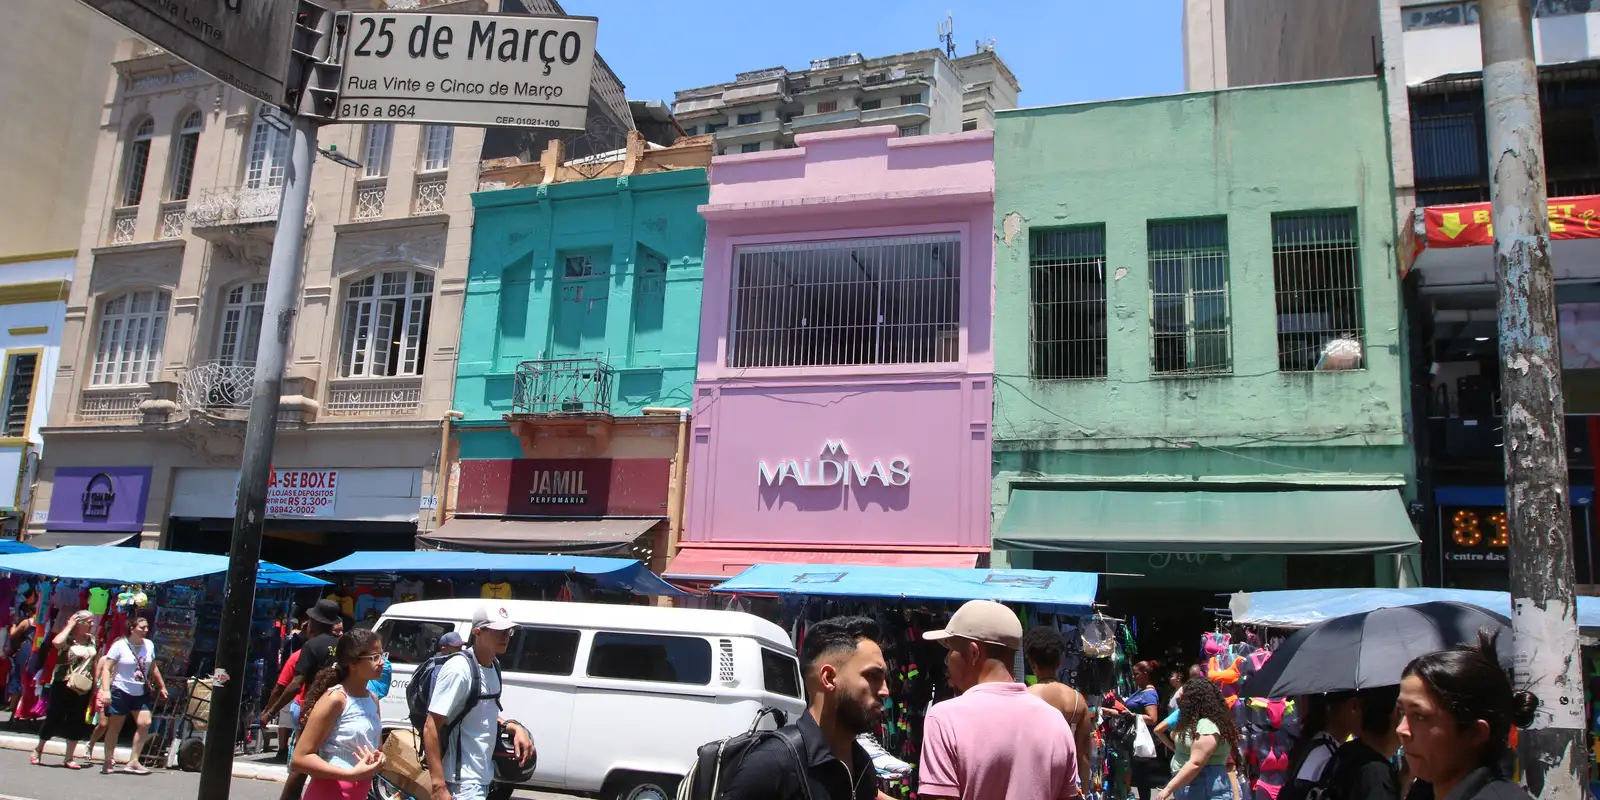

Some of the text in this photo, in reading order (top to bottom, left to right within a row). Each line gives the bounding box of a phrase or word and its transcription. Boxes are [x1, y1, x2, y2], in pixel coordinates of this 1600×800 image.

[184, 6, 222, 40] Leme
[354, 15, 581, 76] 25 de Março
[348, 76, 563, 100] Rua Vinte e Cinco de Março
[342, 104, 416, 118] 816 a 864
[495, 116, 560, 128] CEP 01021-100
[300, 472, 326, 488] BOX
[328, 472, 336, 488] E
[757, 459, 911, 486] MALDIVAS
[529, 470, 588, 495] JAMIL
[288, 497, 300, 506] R$
[423, 496, 438, 506] 795
[530, 496, 585, 504] PERFUMARIA
[269, 506, 316, 514] 98942-0002
[1452, 509, 1510, 547] 81
[1445, 551, 1506, 562] Centro das
